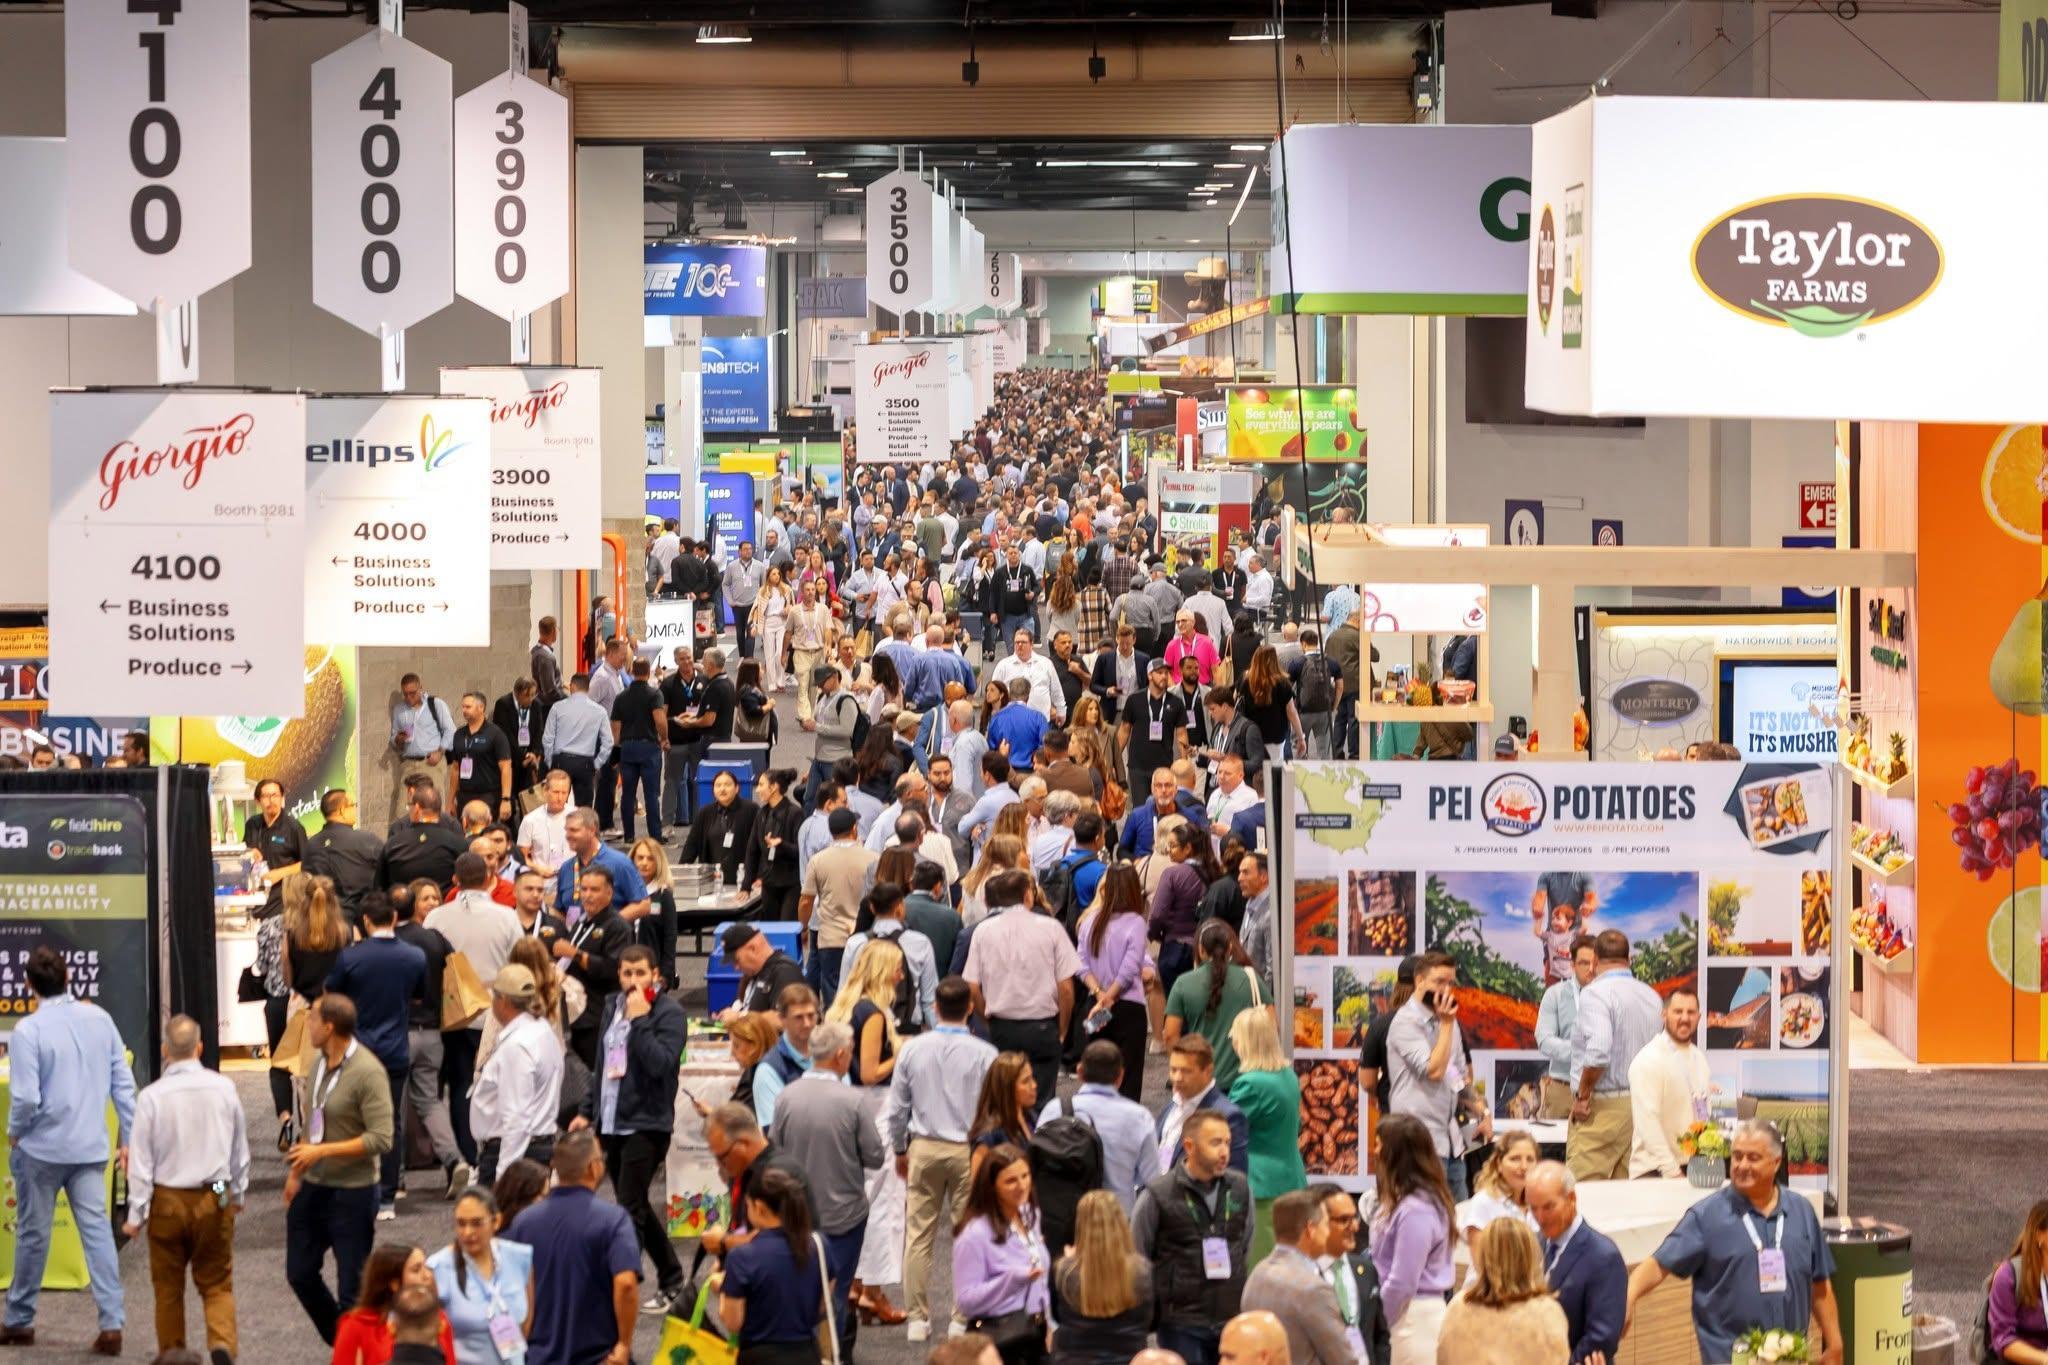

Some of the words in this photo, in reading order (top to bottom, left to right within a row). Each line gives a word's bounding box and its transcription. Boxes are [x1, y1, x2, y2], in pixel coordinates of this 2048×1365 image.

[360, 67, 402, 294] 4000
[494, 100, 527, 285] 3900
[889, 186, 909, 294] 3500
[1729, 218, 1911, 279] Taylor
[1766, 279, 1867, 303] FARMS
[873, 350, 931, 388] Giorgio
[885, 398, 920, 409] 3500
[737, 416, 759, 425] FRESH
[1245, 407, 1265, 419] See
[1268, 408, 1293, 423] why
[1316, 410, 1337, 419] are
[1313, 420, 1344, 432] pears
[99, 412, 254, 511] Giorgio
[306, 439, 415, 468] ellips
[492, 469, 550, 485] 3900
[492, 496, 555, 507] Business
[650, 491, 681, 501] PEOPL
[214, 503, 257, 517] Booth
[259, 503, 295, 517] 3281
[492, 511, 559, 522] Solutions
[354, 522, 427, 541] 4000
[492, 532, 550, 543] Produce
[131, 555, 221, 581] 4100
[354, 556, 431, 569] Business
[354, 574, 436, 588] Solutions
[128, 598, 229, 617] Business
[354, 601, 426, 614] Produce
[128, 623, 236, 642] Solutions
[1725, 637, 1792, 645] NATIONWIDE
[1796, 637, 1827, 645] FROM
[128, 658, 222, 676] Produce
[1620, 697, 1694, 712] MONTEREY
[1749, 711, 1777, 733] IT'S
[1780, 711, 1810, 732] NOT
[1749, 733, 1777, 753] IT'S
[1429, 786, 1472, 821] PEI
[1553, 785, 1696, 821] POTATOES
[69, 818, 123, 832] fieldhire
[1554, 823, 1664, 833] WWW.PEIPOTATO.COM
[67, 844, 123, 856] traceback
[2, 967, 14, 981] &
